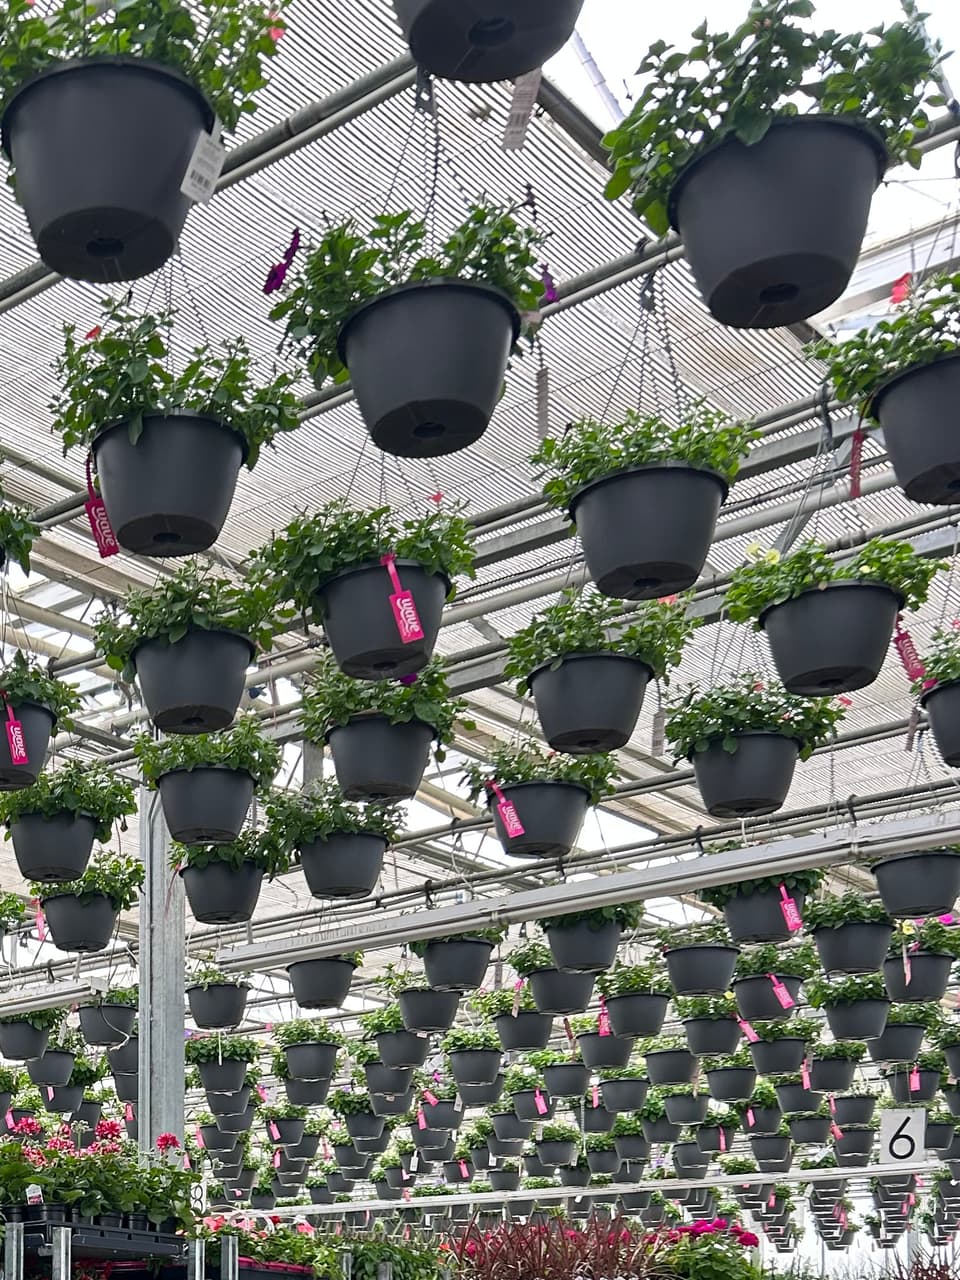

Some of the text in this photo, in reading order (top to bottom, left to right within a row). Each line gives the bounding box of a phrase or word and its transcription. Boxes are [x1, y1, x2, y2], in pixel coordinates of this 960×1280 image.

[94, 506, 116, 546] wave
[400, 597, 420, 633] wave
[13, 726, 27, 759] wave
[889, 1116, 915, 1160] 6
